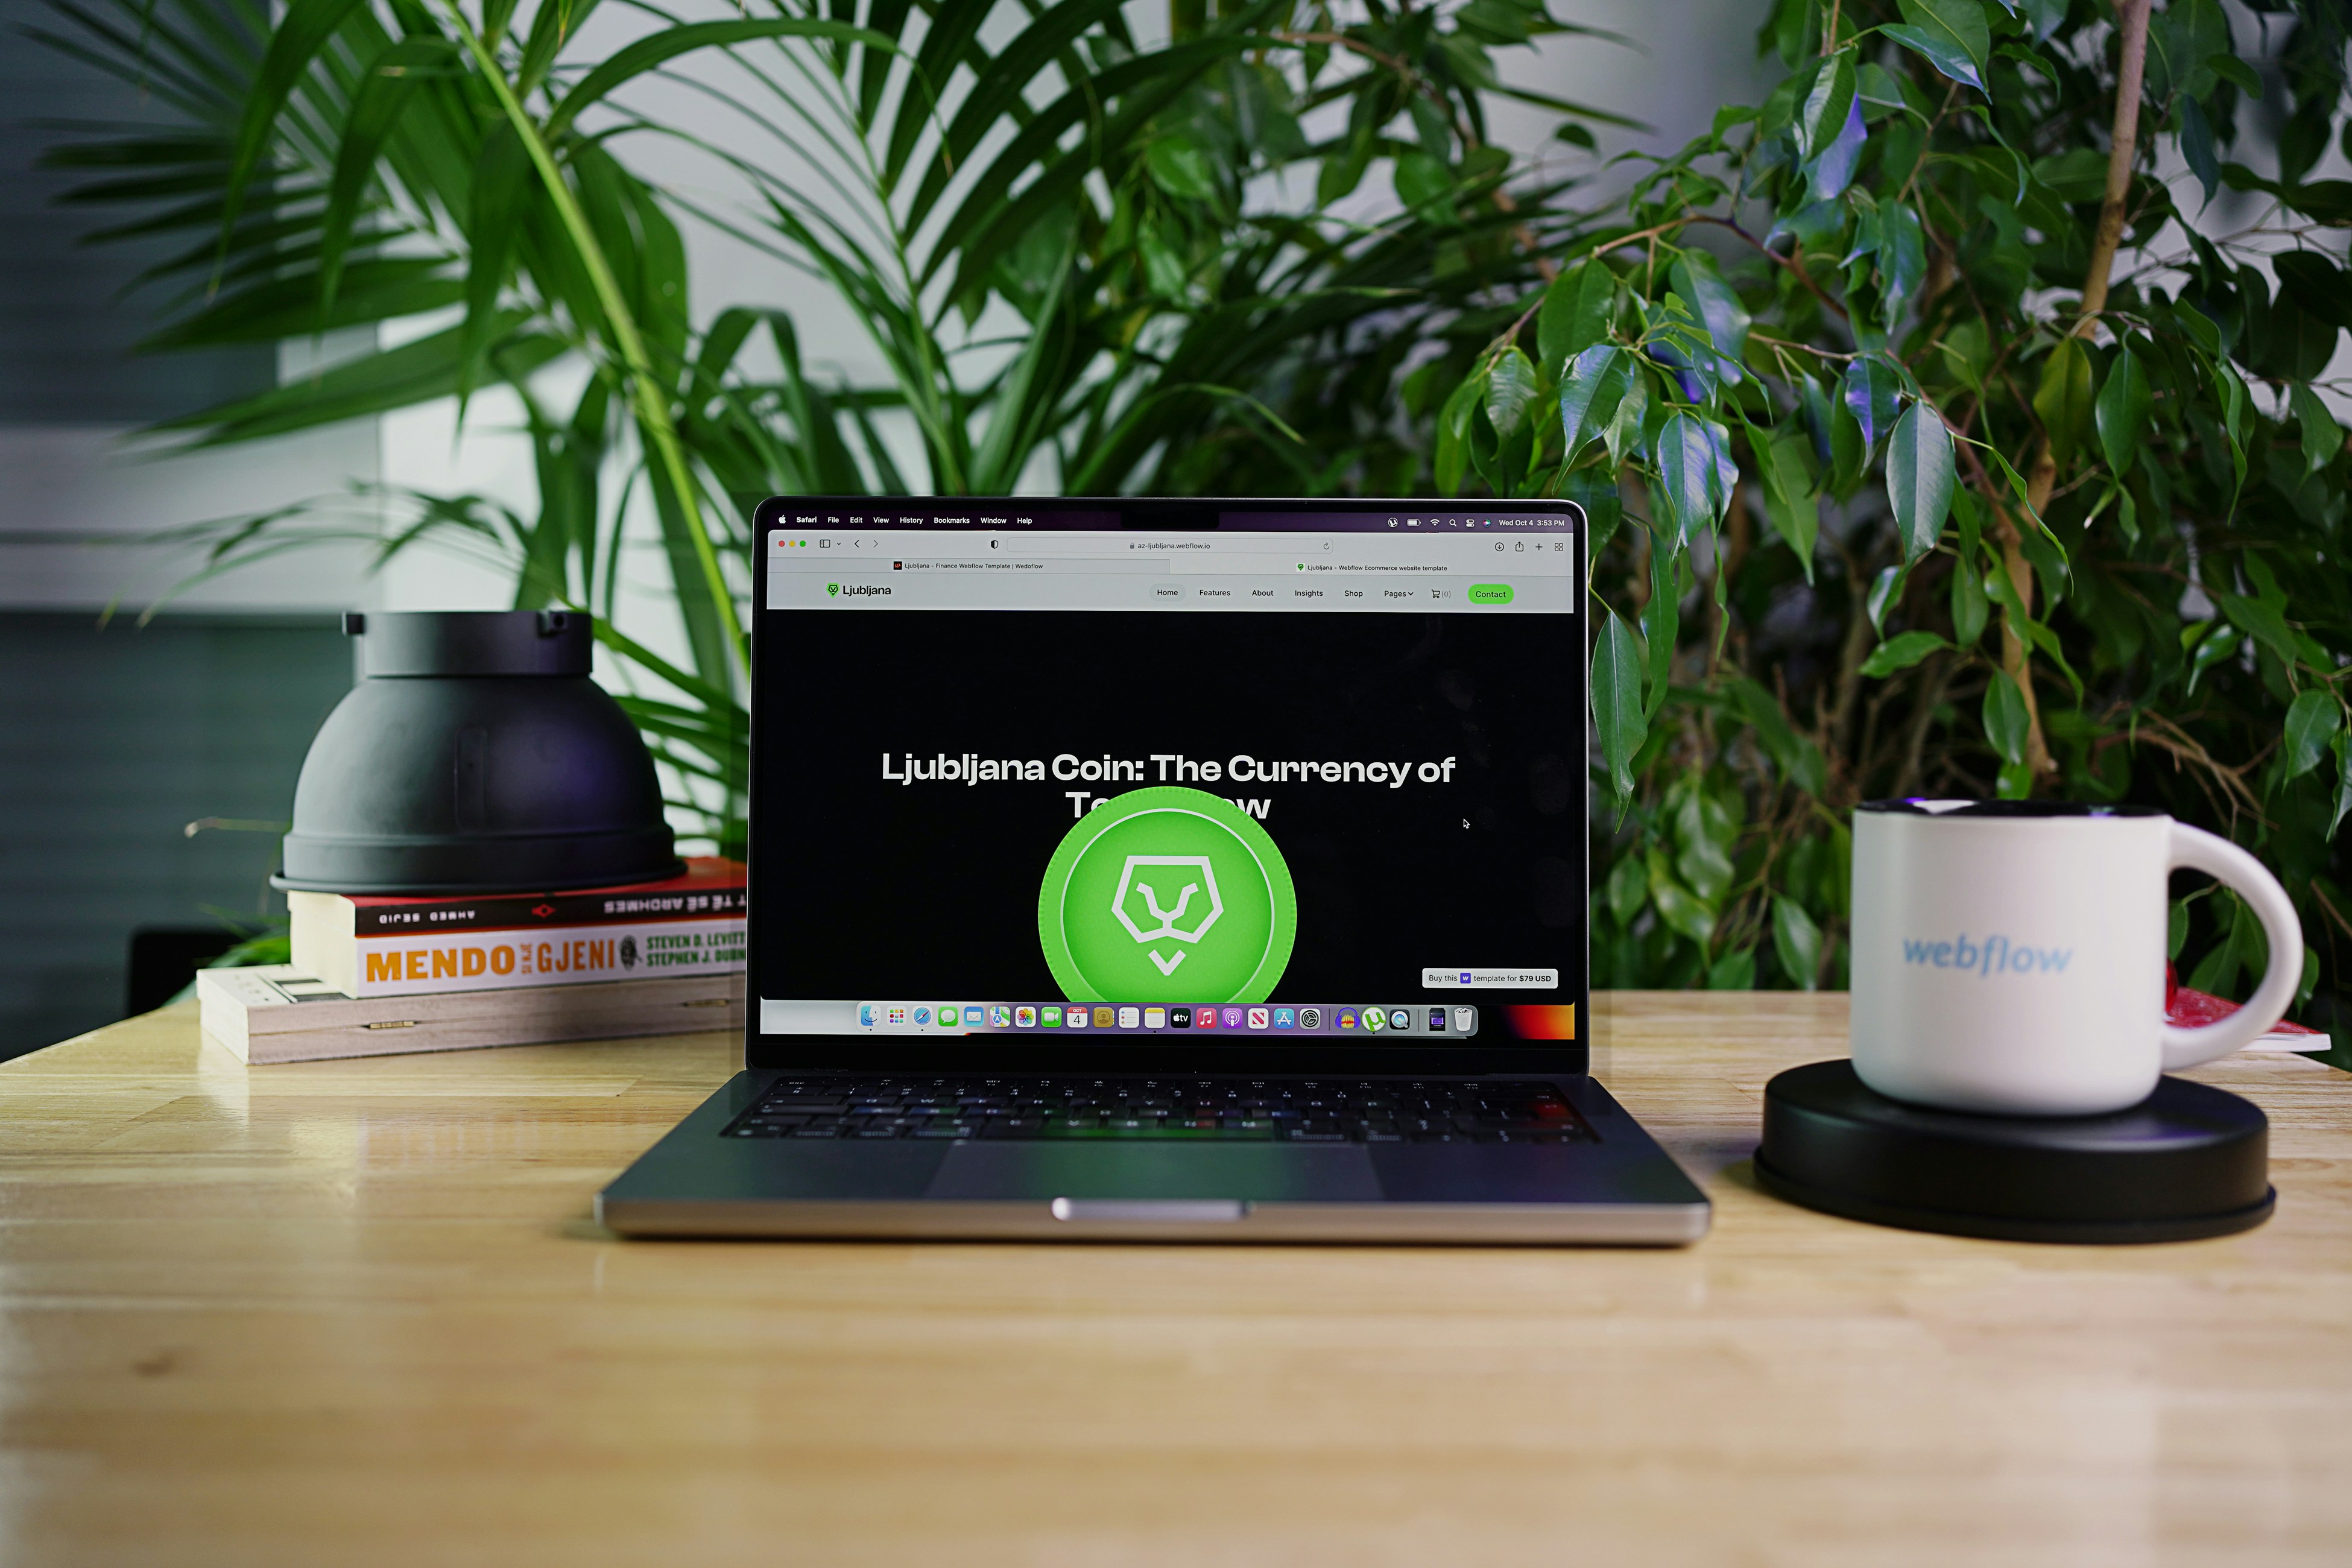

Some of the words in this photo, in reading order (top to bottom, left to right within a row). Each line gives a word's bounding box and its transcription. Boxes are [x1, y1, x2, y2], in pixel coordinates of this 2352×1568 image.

[900, 516, 923, 525] History
[1017, 517, 1032, 525] Help
[1137, 542, 1210, 551] az-ljubljana.webflow.io
[842, 584, 891, 597] Ljubljana
[1295, 589, 1323, 598] Insights
[1344, 590, 1364, 599] Shop
[1384, 590, 1406, 599] Pages
[882, 753, 1046, 786] Ljubljana
[1052, 753, 1144, 782] Coin:
[1150, 754, 1222, 782] The
[1228, 754, 1413, 789] Currency
[1417, 756, 1456, 783] of
[646, 935, 691, 950] STEVEN
[537, 939, 615, 974] GJENI
[646, 950, 699, 967] STEPHEN
[1903, 933, 2073, 977] webflow
[366, 944, 516, 982] MENDO
[1429, 974, 1443, 983] Buy
[1444, 974, 1458, 982] this
[1473, 975, 1505, 984] template
[1073, 1014, 1081, 1025] 4
